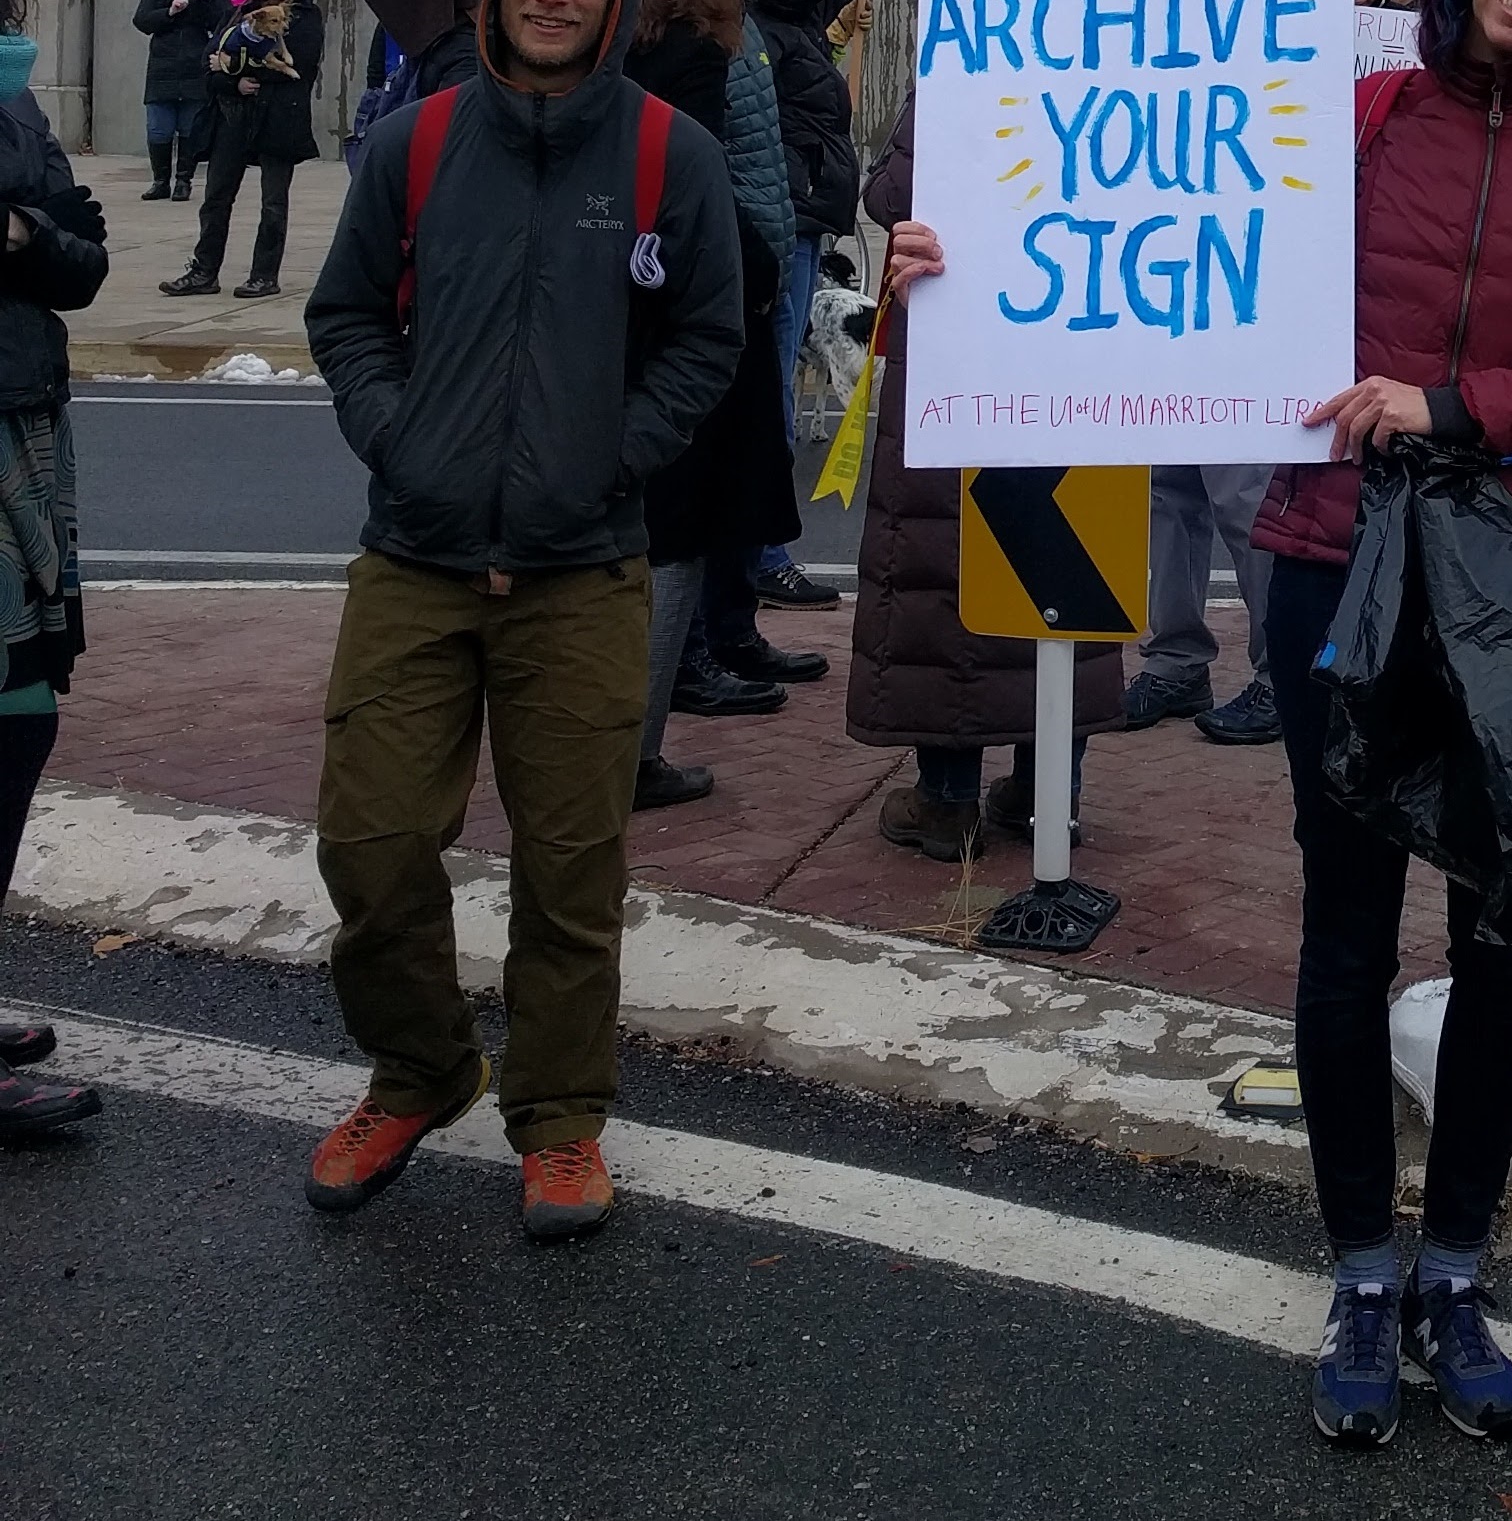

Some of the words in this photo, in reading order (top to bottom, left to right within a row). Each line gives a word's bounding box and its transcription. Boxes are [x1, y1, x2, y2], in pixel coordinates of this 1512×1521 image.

[1041, 85, 1266, 203] YOUR
[997, 209, 1264, 339] SIGN
[920, 394, 964, 428] AT
[971, 394, 1040, 425] THE
[1119, 394, 1256, 427] MARRIOTT
